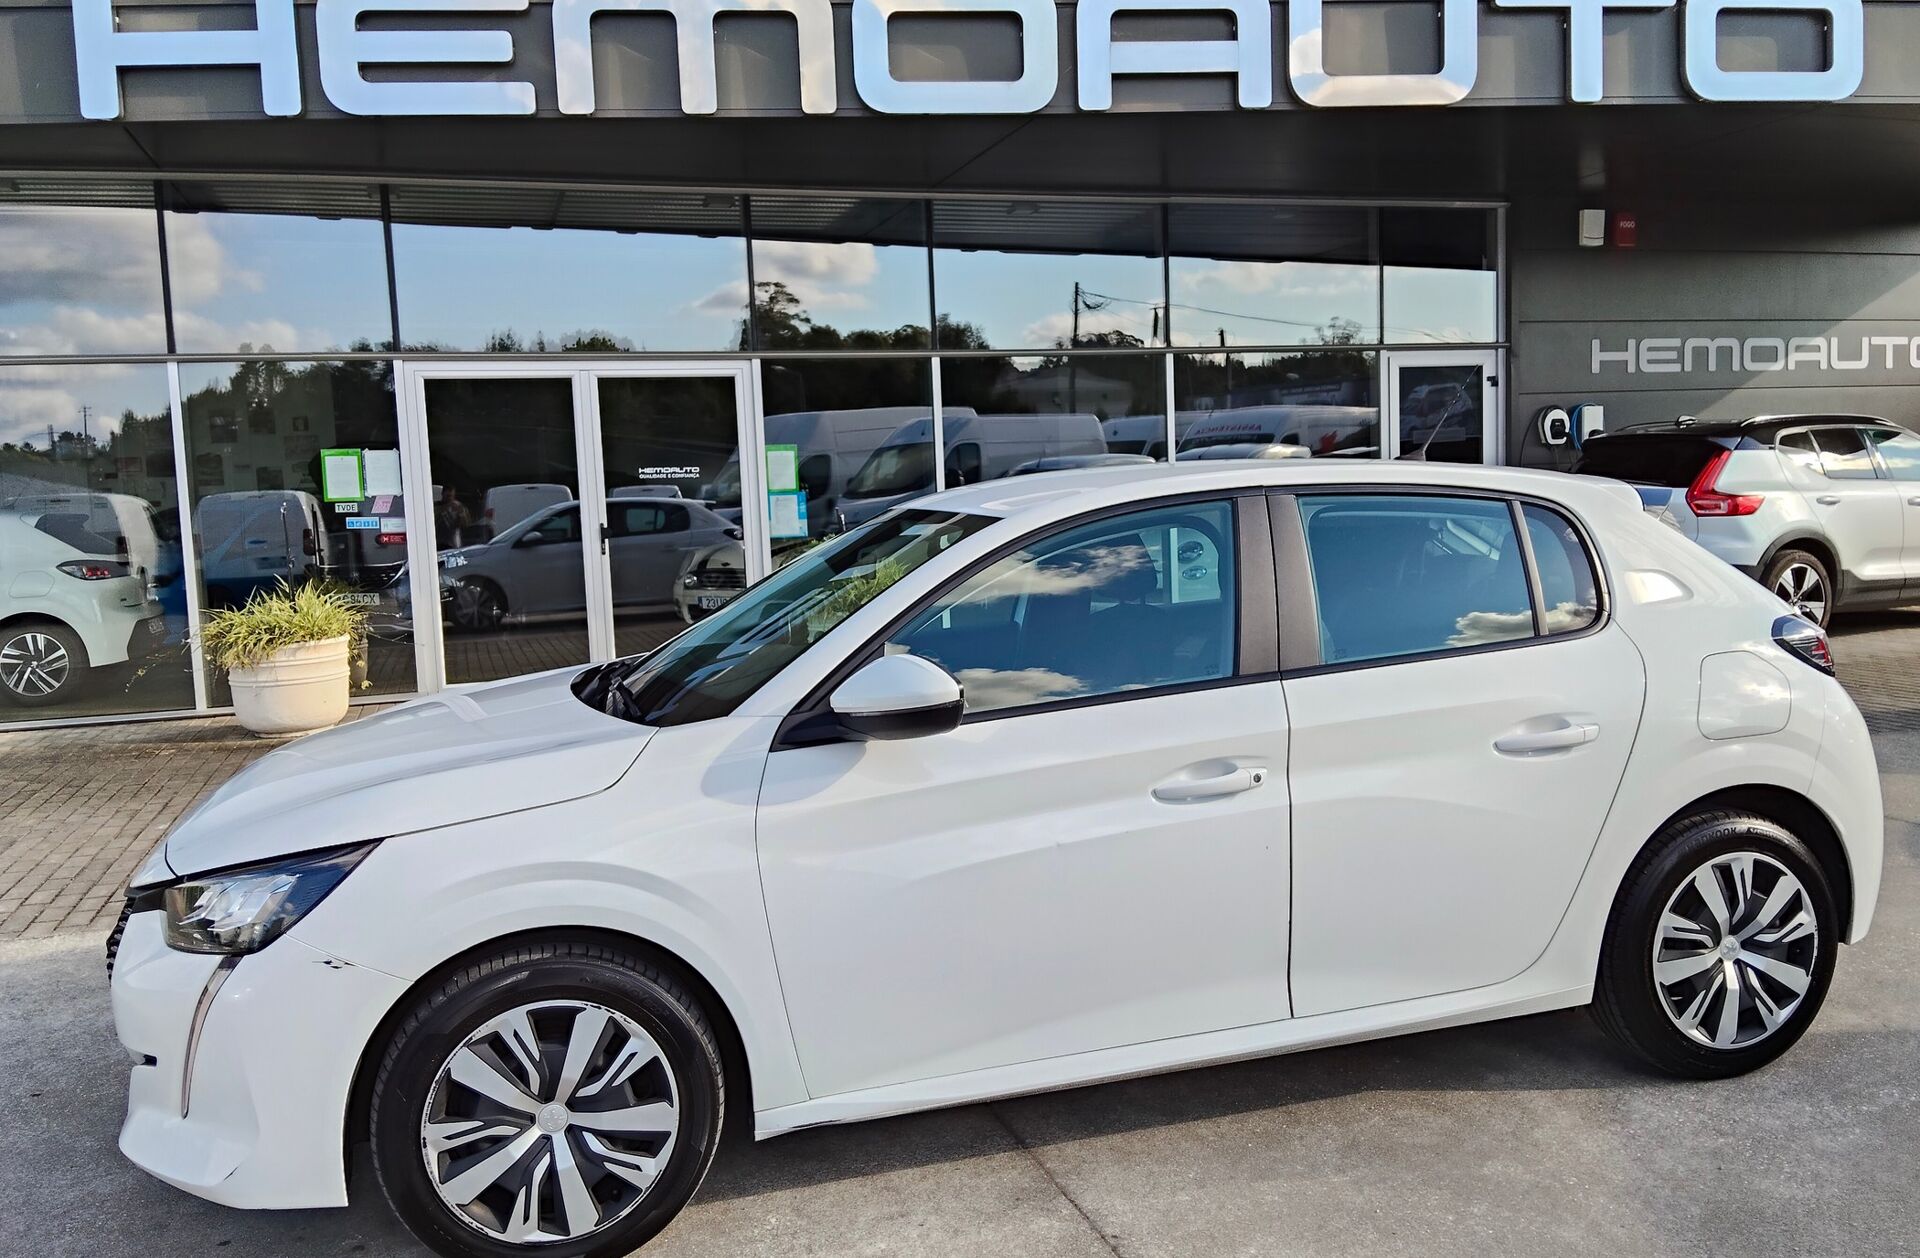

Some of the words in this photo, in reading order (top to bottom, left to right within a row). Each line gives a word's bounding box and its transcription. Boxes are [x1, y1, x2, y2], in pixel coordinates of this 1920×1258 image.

[73, 0, 1864, 119] HEMOAUTO
[1620, 220, 1636, 228] FOGO
[1591, 336, 1920, 373] HEMOAUT
[638, 466, 700, 474] HEMOAUTO
